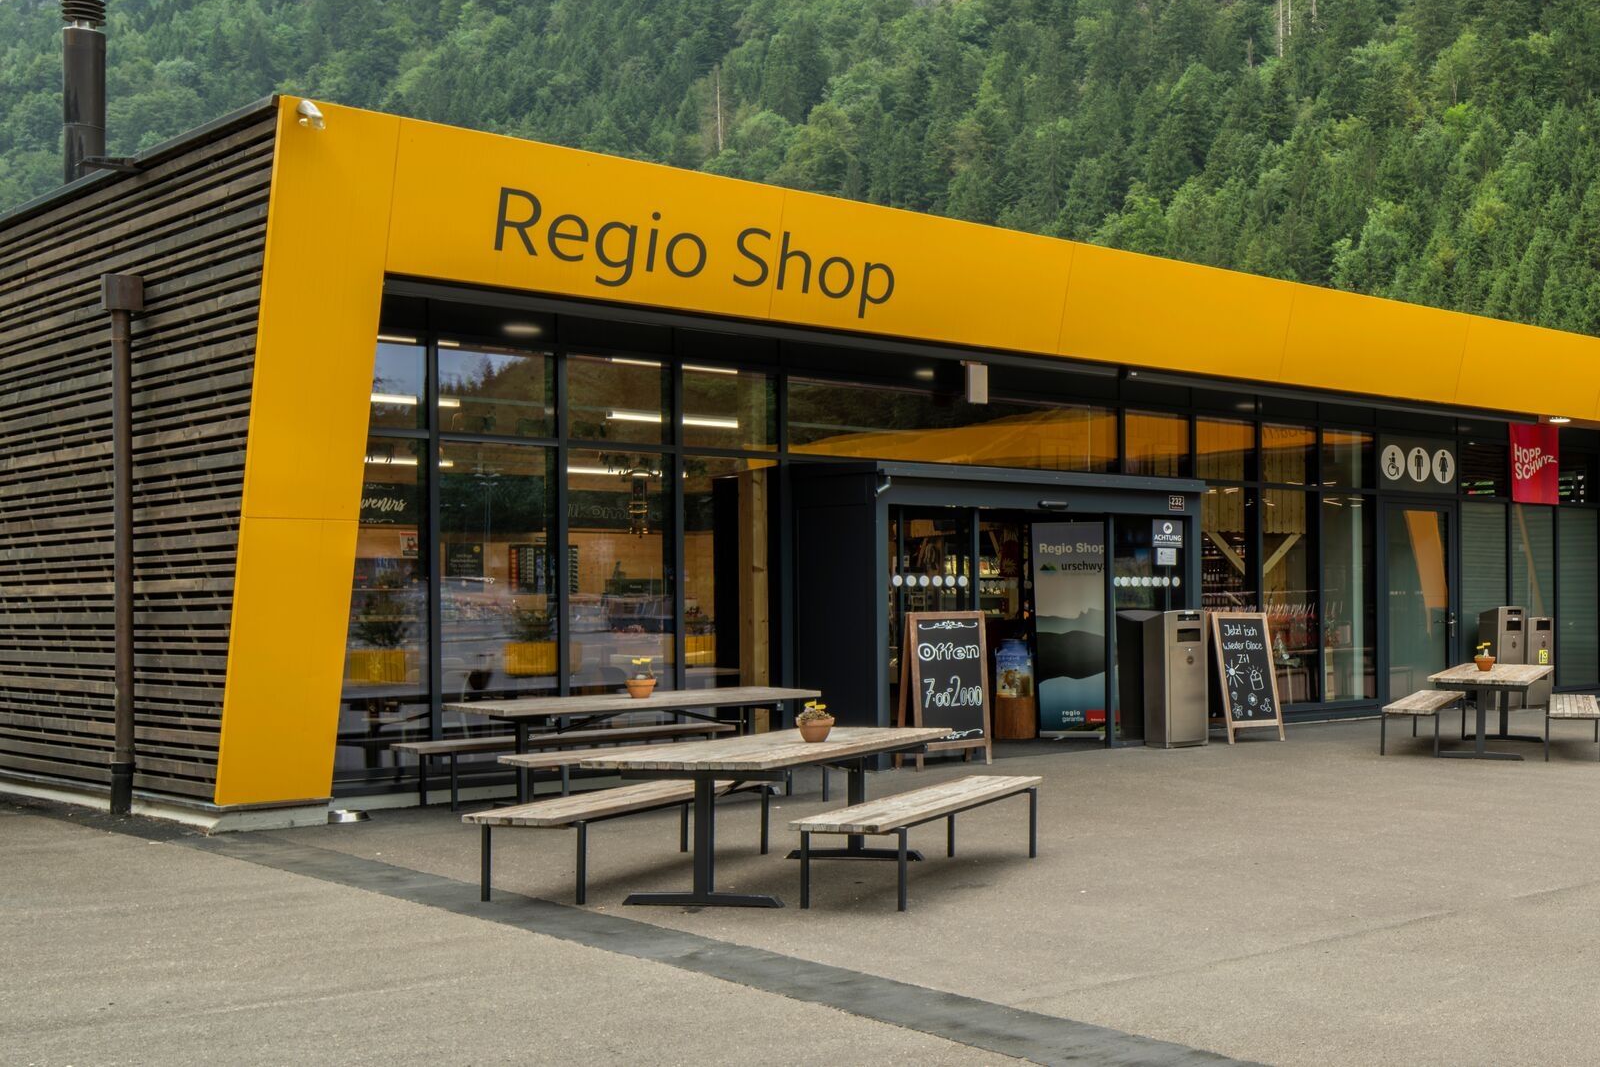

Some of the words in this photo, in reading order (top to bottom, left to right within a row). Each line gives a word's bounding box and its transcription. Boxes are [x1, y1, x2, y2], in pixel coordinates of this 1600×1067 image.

[494, 187, 707, 287] Regio
[733, 228, 895, 318] Shop
[1514, 443, 1541, 463] HOPP
[1515, 455, 1557, 480] SCHWYZ
[360, 497, 407, 512] venirs
[1171, 497, 1182, 505] 232
[1154, 534, 1182, 542] ACHTUNG
[1039, 543, 1073, 555] Regio
[1061, 561, 1105, 572] urschwy
[918, 642, 980, 661] Offen
